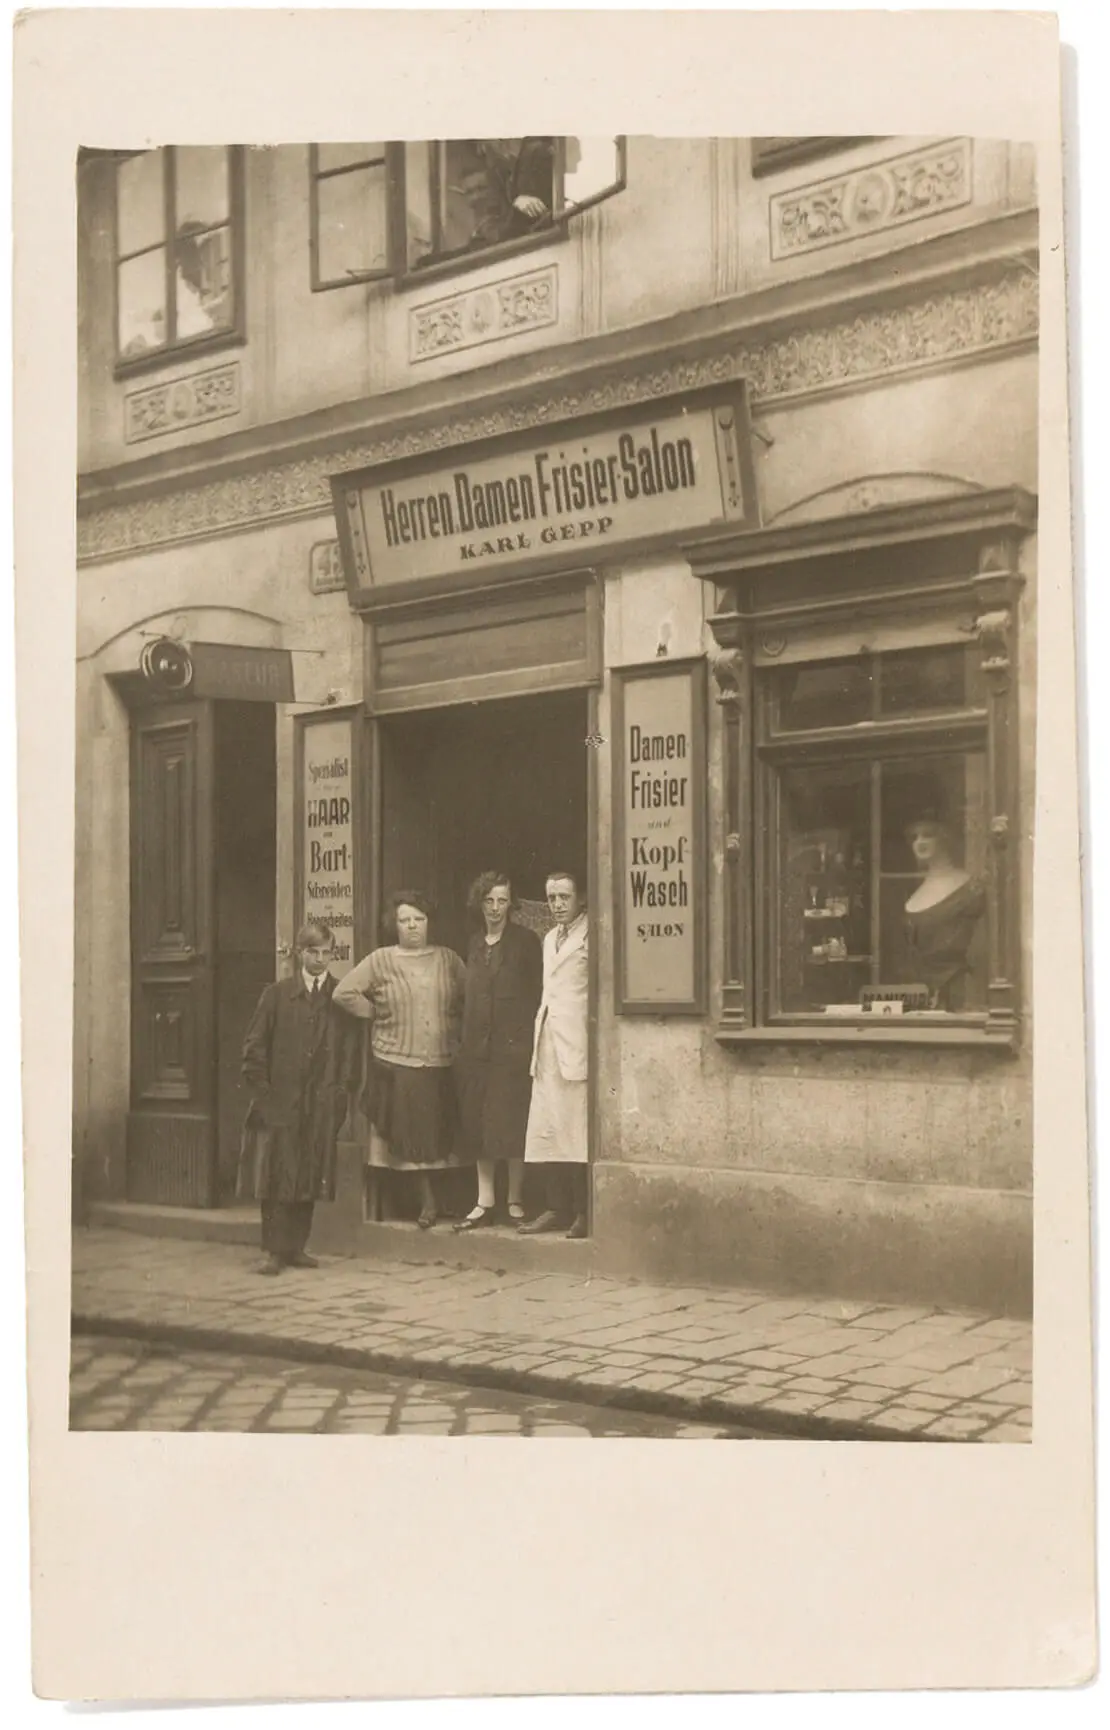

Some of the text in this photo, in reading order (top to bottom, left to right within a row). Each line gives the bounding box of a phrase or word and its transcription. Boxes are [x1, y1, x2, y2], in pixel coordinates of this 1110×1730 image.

[454, 473, 536, 532] Damen
[460, 516, 612, 560] KARL GEPP
[630, 725, 686, 764] Damen
[631, 769, 688, 809] Frisier
[307, 797, 350, 829] HAAR
[630, 869, 688, 908] Wasch
[637, 922, 684, 940] SALON
